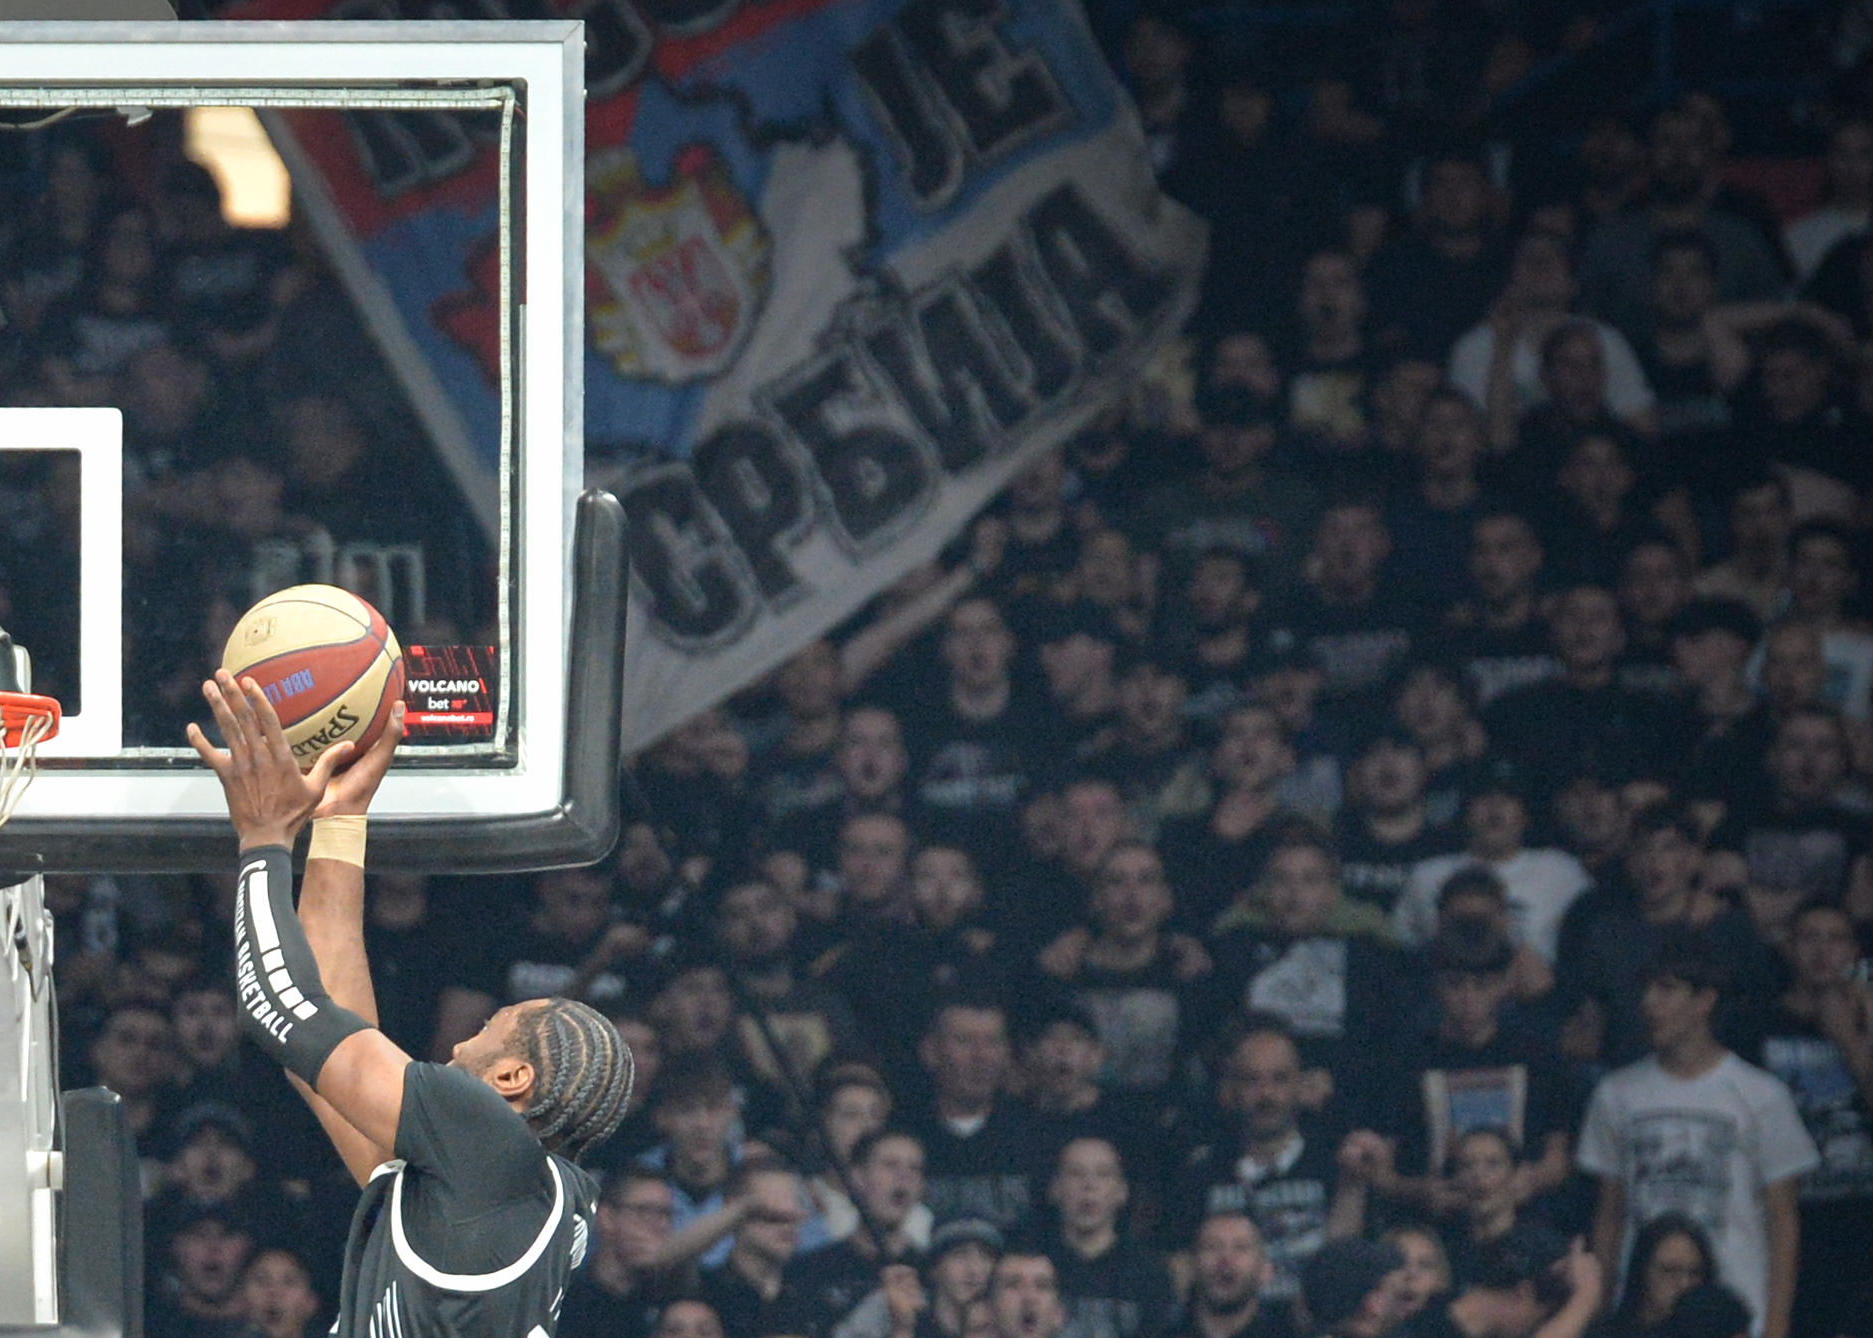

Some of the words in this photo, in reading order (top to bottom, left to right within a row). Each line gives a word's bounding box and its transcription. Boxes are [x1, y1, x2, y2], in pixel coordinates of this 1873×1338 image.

[408, 679, 480, 693] VOLCANO
[428, 696, 449, 709] bet
[291, 703, 360, 757] SPALD
[237, 940, 294, 1045] BASKETBALL
